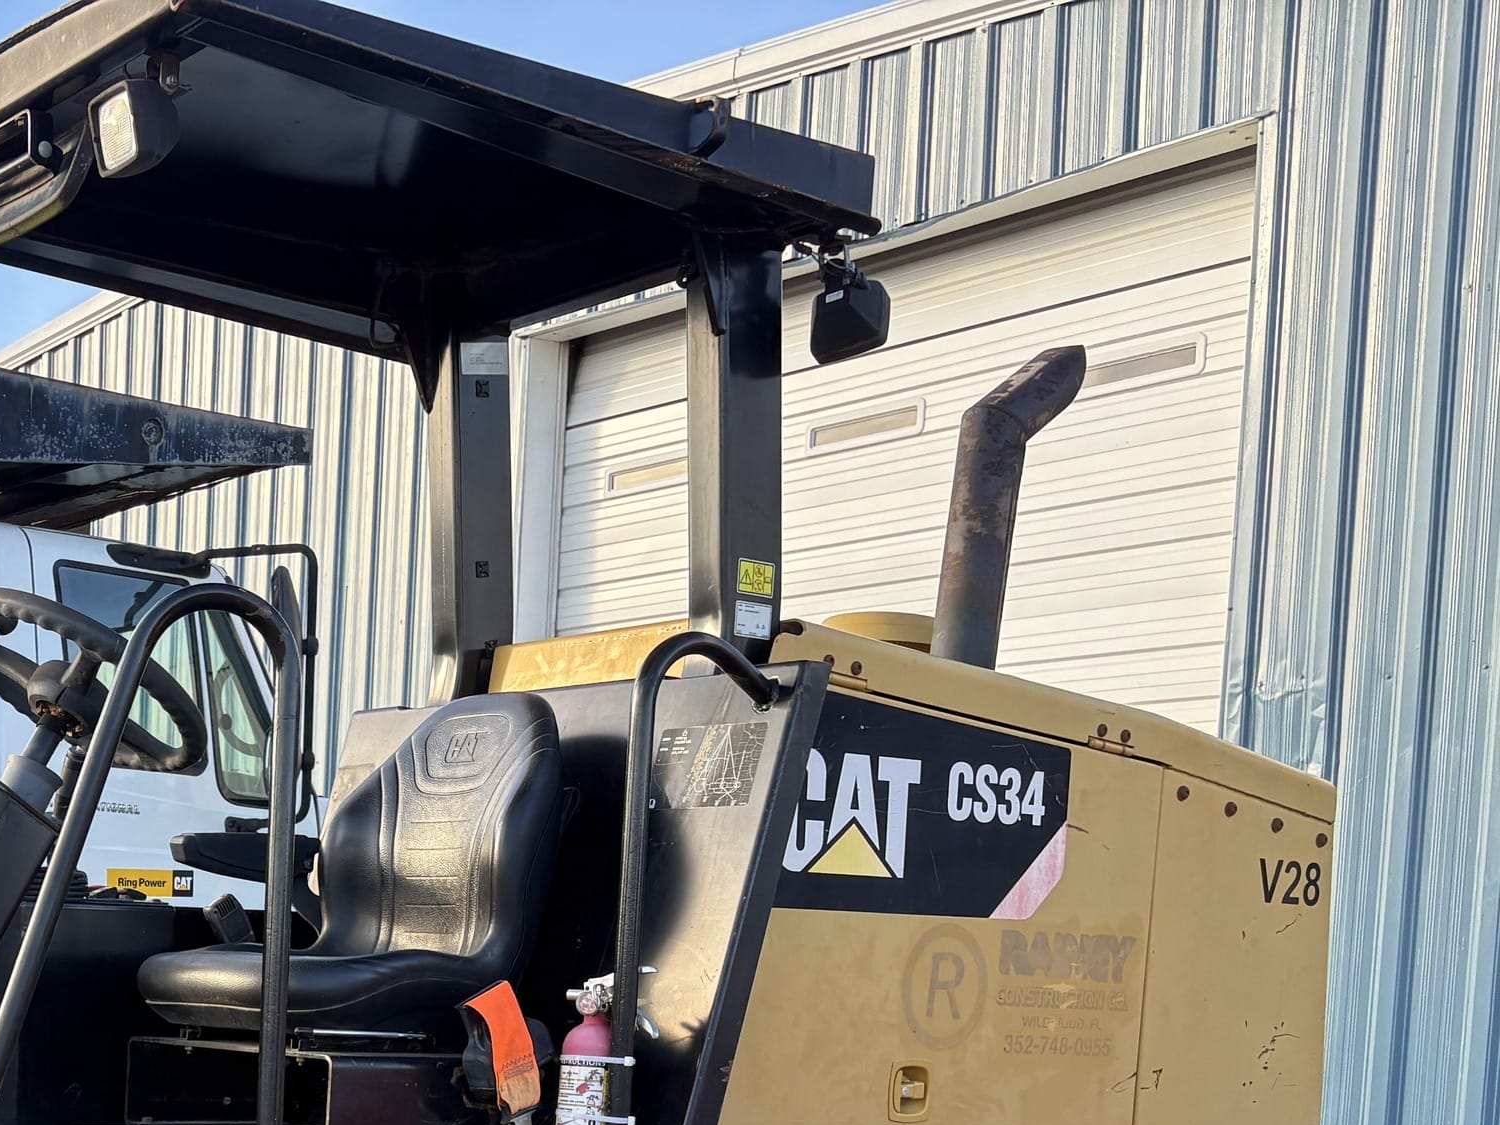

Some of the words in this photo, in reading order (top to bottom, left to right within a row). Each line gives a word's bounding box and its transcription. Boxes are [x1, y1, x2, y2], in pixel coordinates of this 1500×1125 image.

[782, 747, 922, 879] CAT
[947, 761, 1046, 827] CS34
[117, 877, 138, 889] Ring
[138, 877, 167, 888] Power
[173, 876, 193, 891] CAT
[1259, 857, 1322, 907] V28
[925, 951, 966, 1021] R
